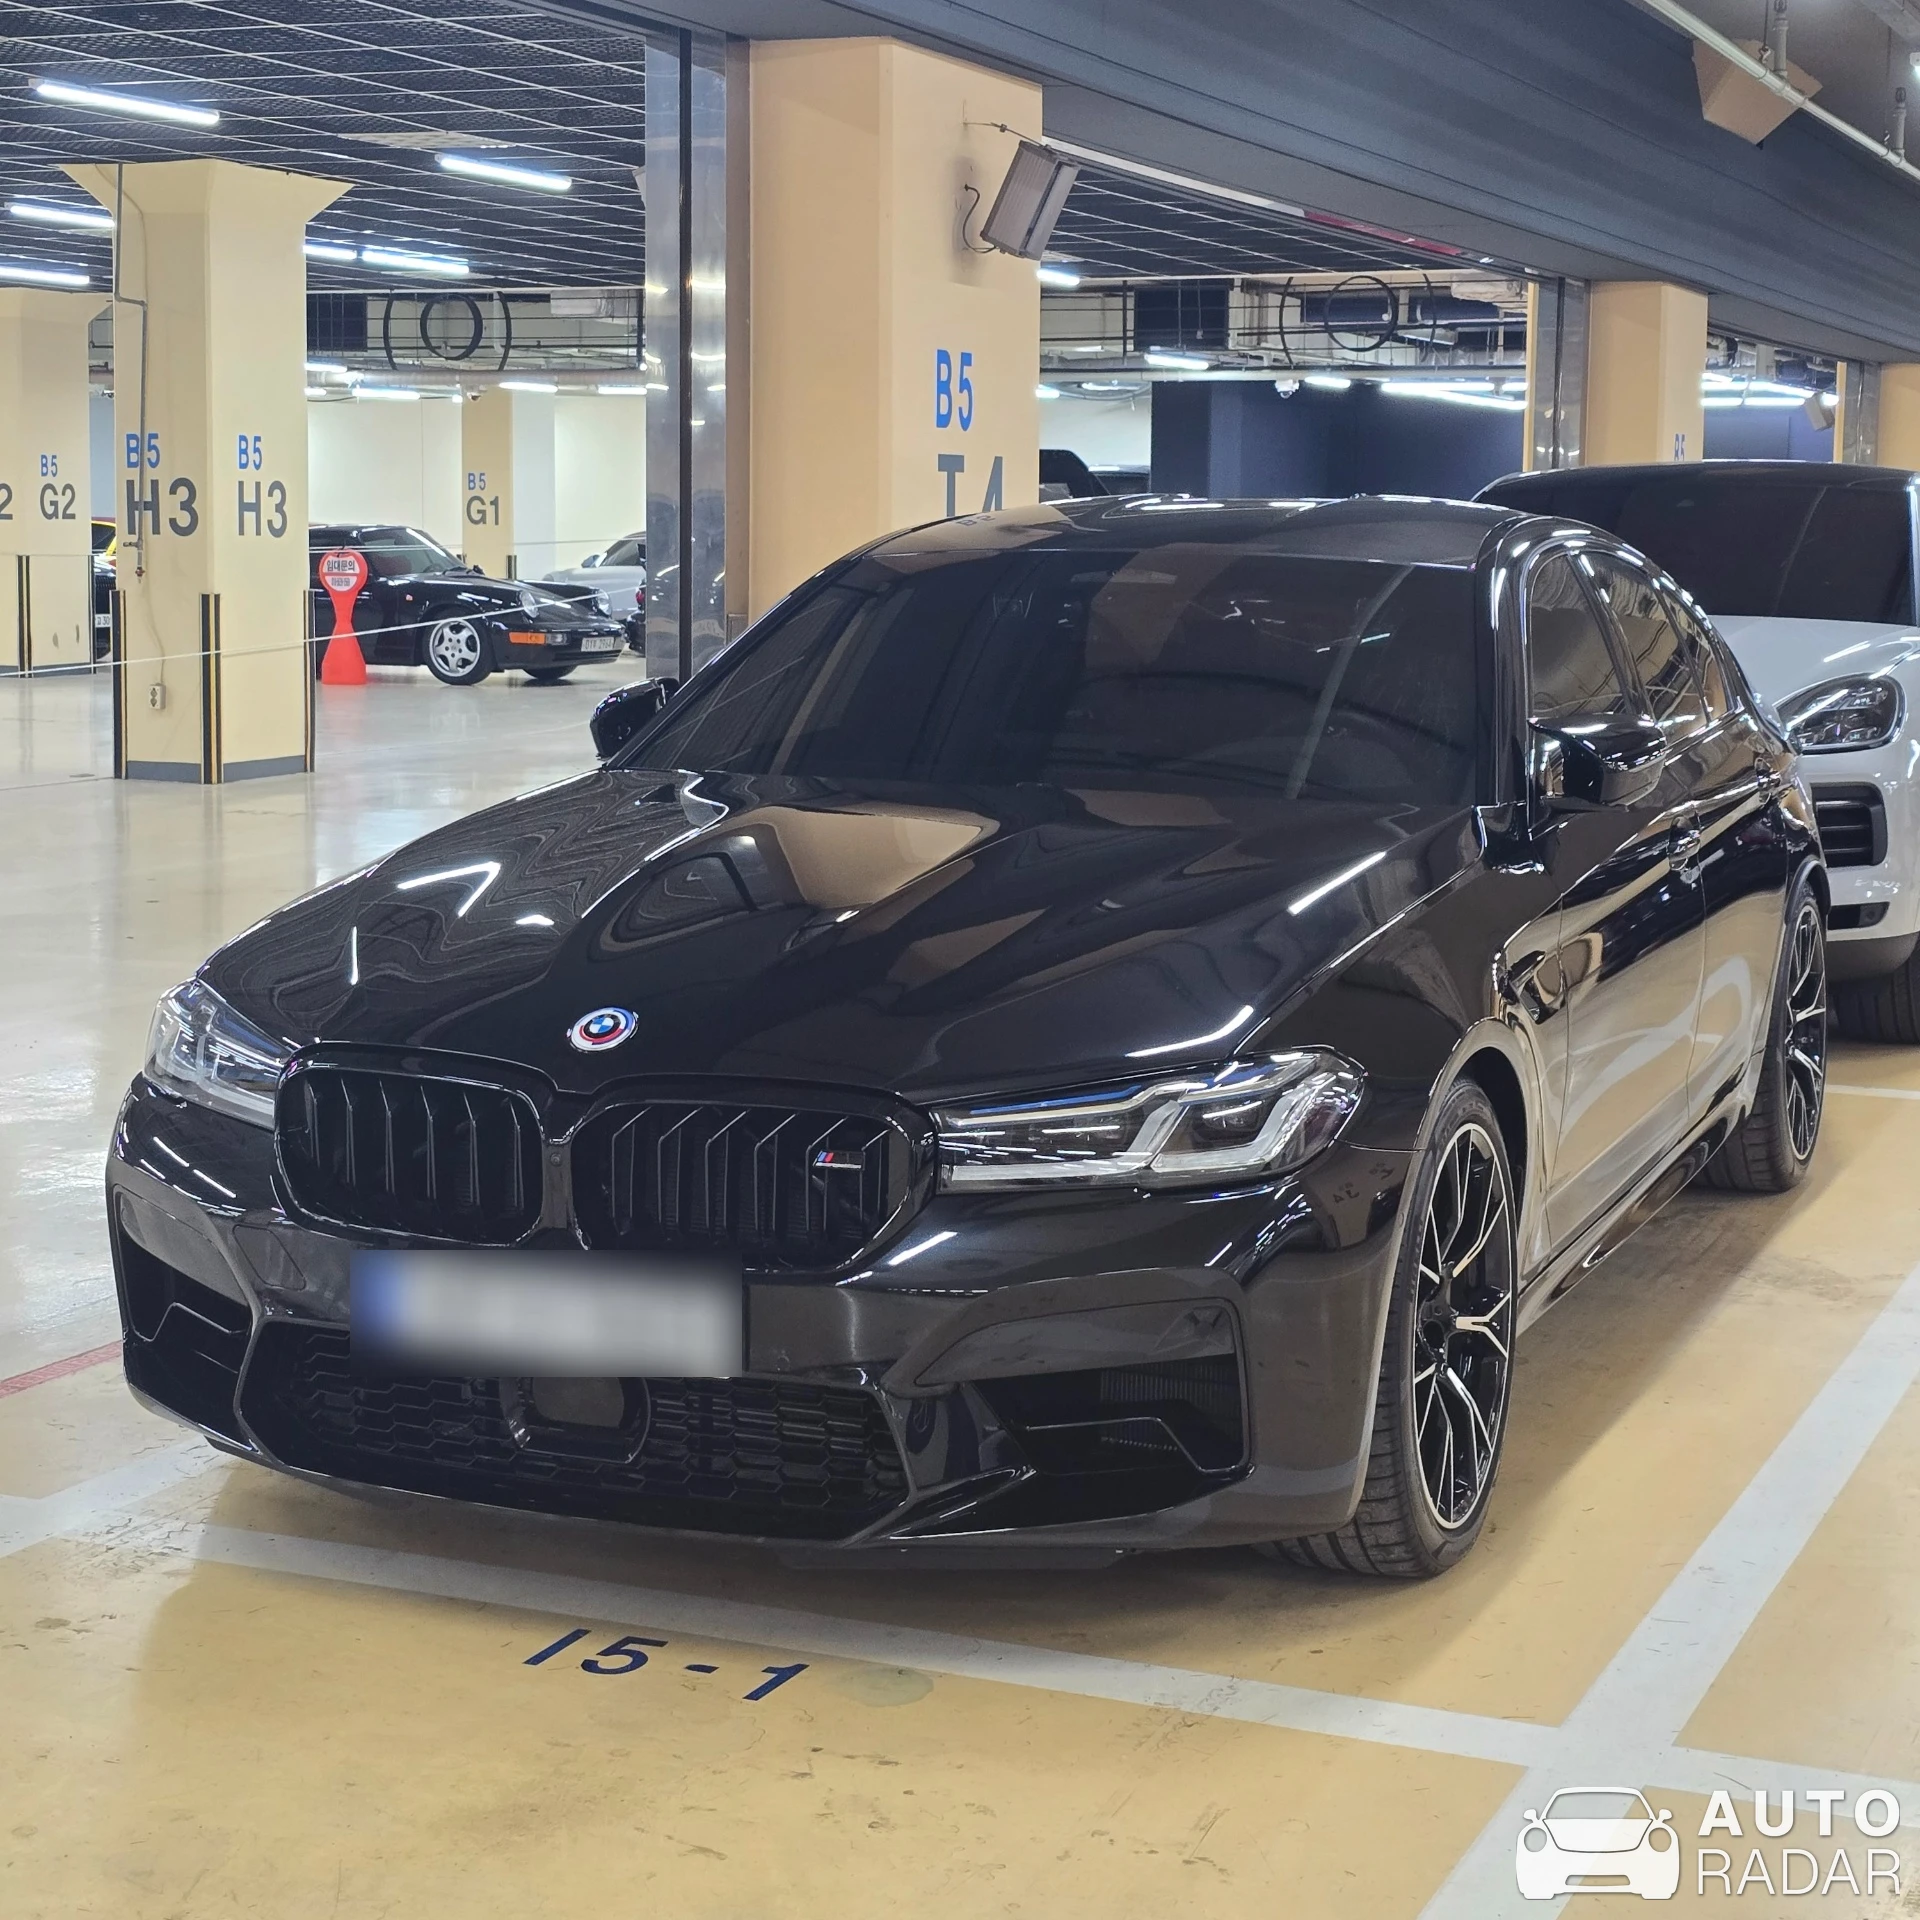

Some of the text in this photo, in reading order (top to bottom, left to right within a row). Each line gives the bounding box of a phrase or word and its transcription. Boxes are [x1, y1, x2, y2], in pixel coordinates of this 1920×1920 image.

[936, 350, 973, 431] B5
[41, 454, 58, 477] B5
[125, 433, 160, 468] B5
[238, 435, 262, 470] B5
[467, 472, 486, 491] B5
[40, 483, 76, 520] G2
[126, 477, 199, 537] H3
[238, 480, 288, 538] H3
[466, 495, 499, 526] G1
[326, 559, 355, 572] 임대문의
